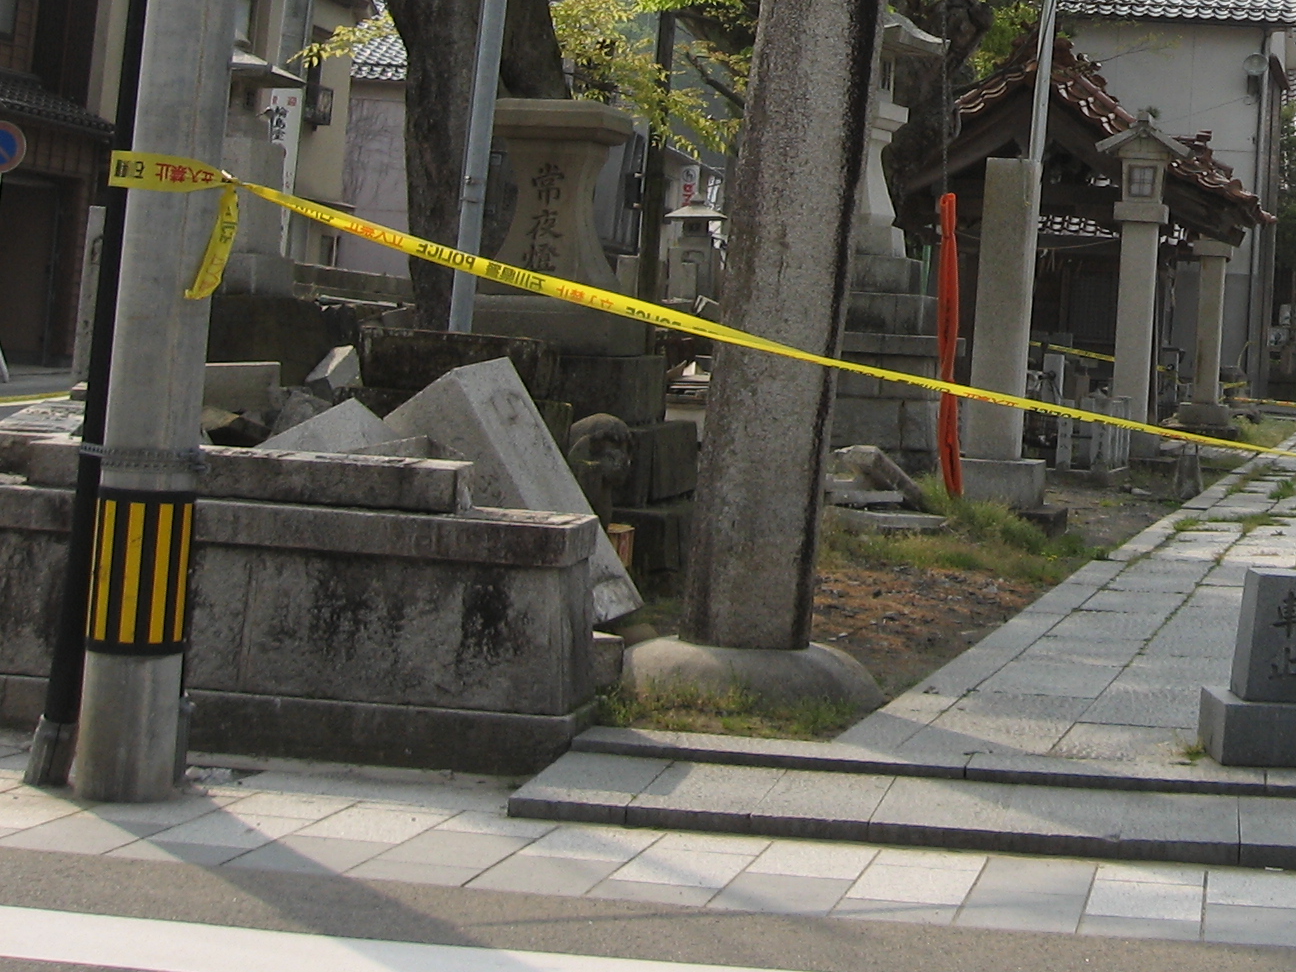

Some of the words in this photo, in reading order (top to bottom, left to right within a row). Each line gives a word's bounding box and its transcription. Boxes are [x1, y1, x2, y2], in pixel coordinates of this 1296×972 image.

[155, 162, 214, 184] 立入禁止
[522, 162, 565, 272] 常夜燈
